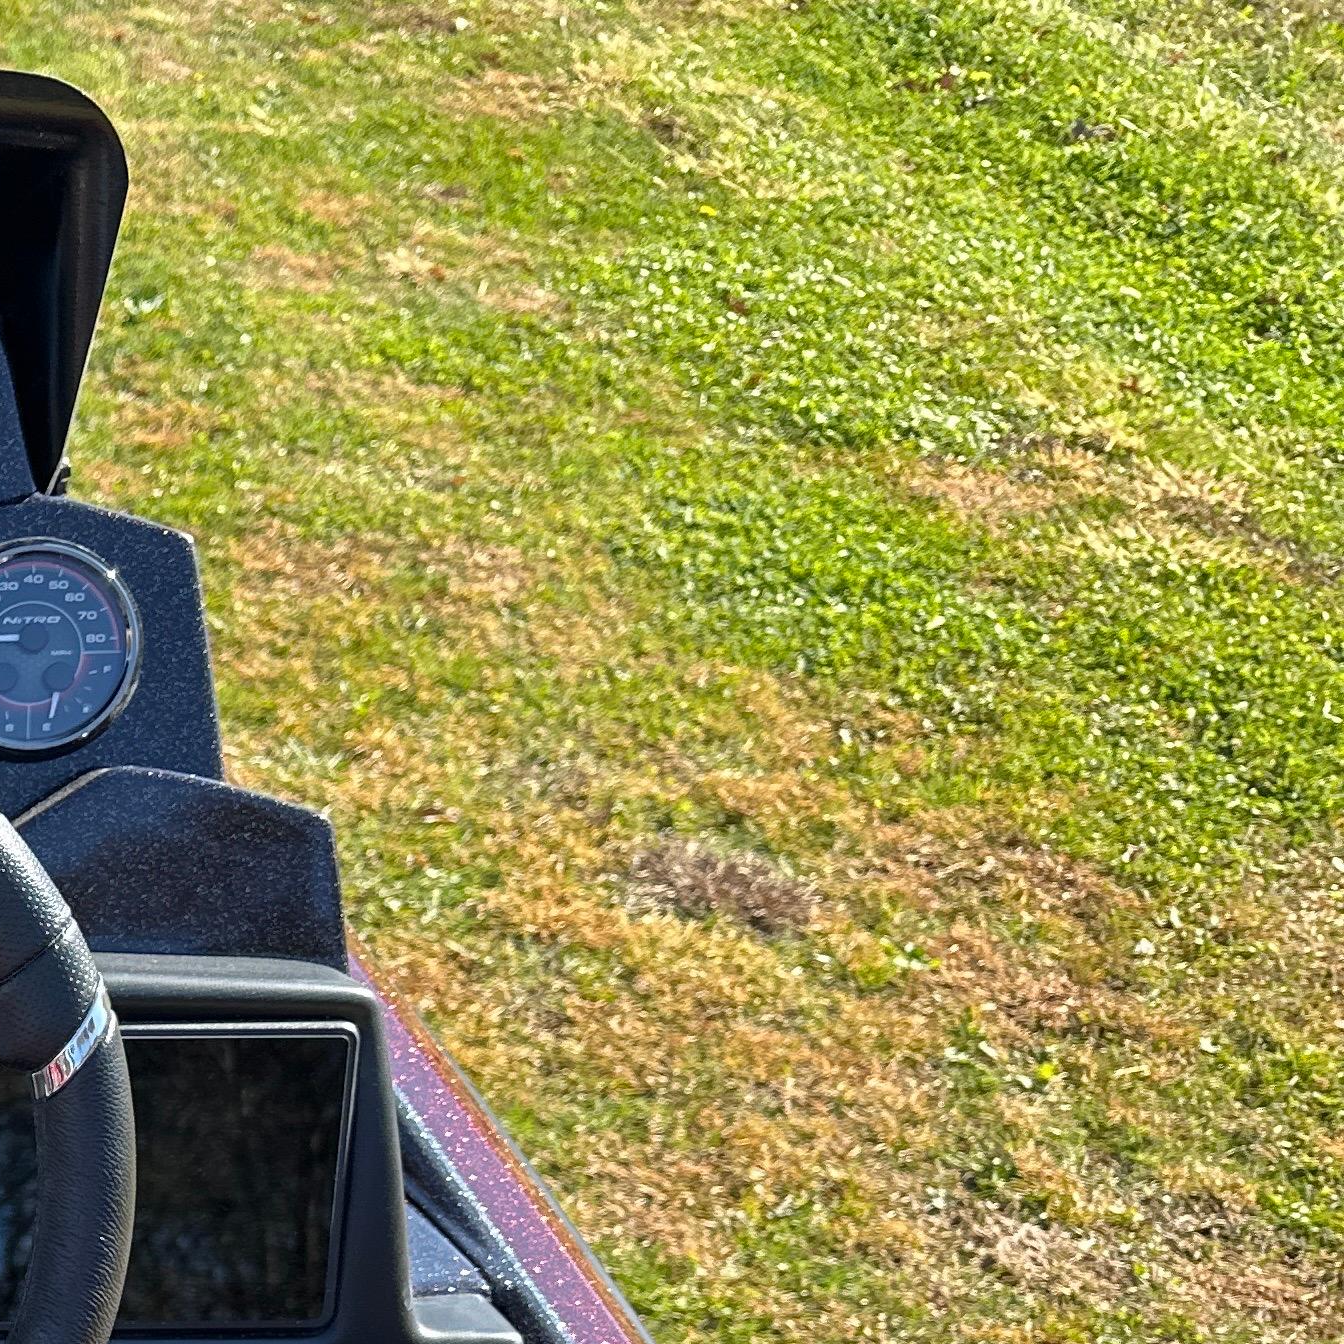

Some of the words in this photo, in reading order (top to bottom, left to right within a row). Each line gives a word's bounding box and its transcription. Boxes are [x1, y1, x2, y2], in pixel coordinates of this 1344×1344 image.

[23, 574, 44, 584] 40
[48, 580, 69, 590] 50
[64, 592, 85, 602] 60
[77, 611, 98, 620] 70
[85, 634, 106, 643] 80
